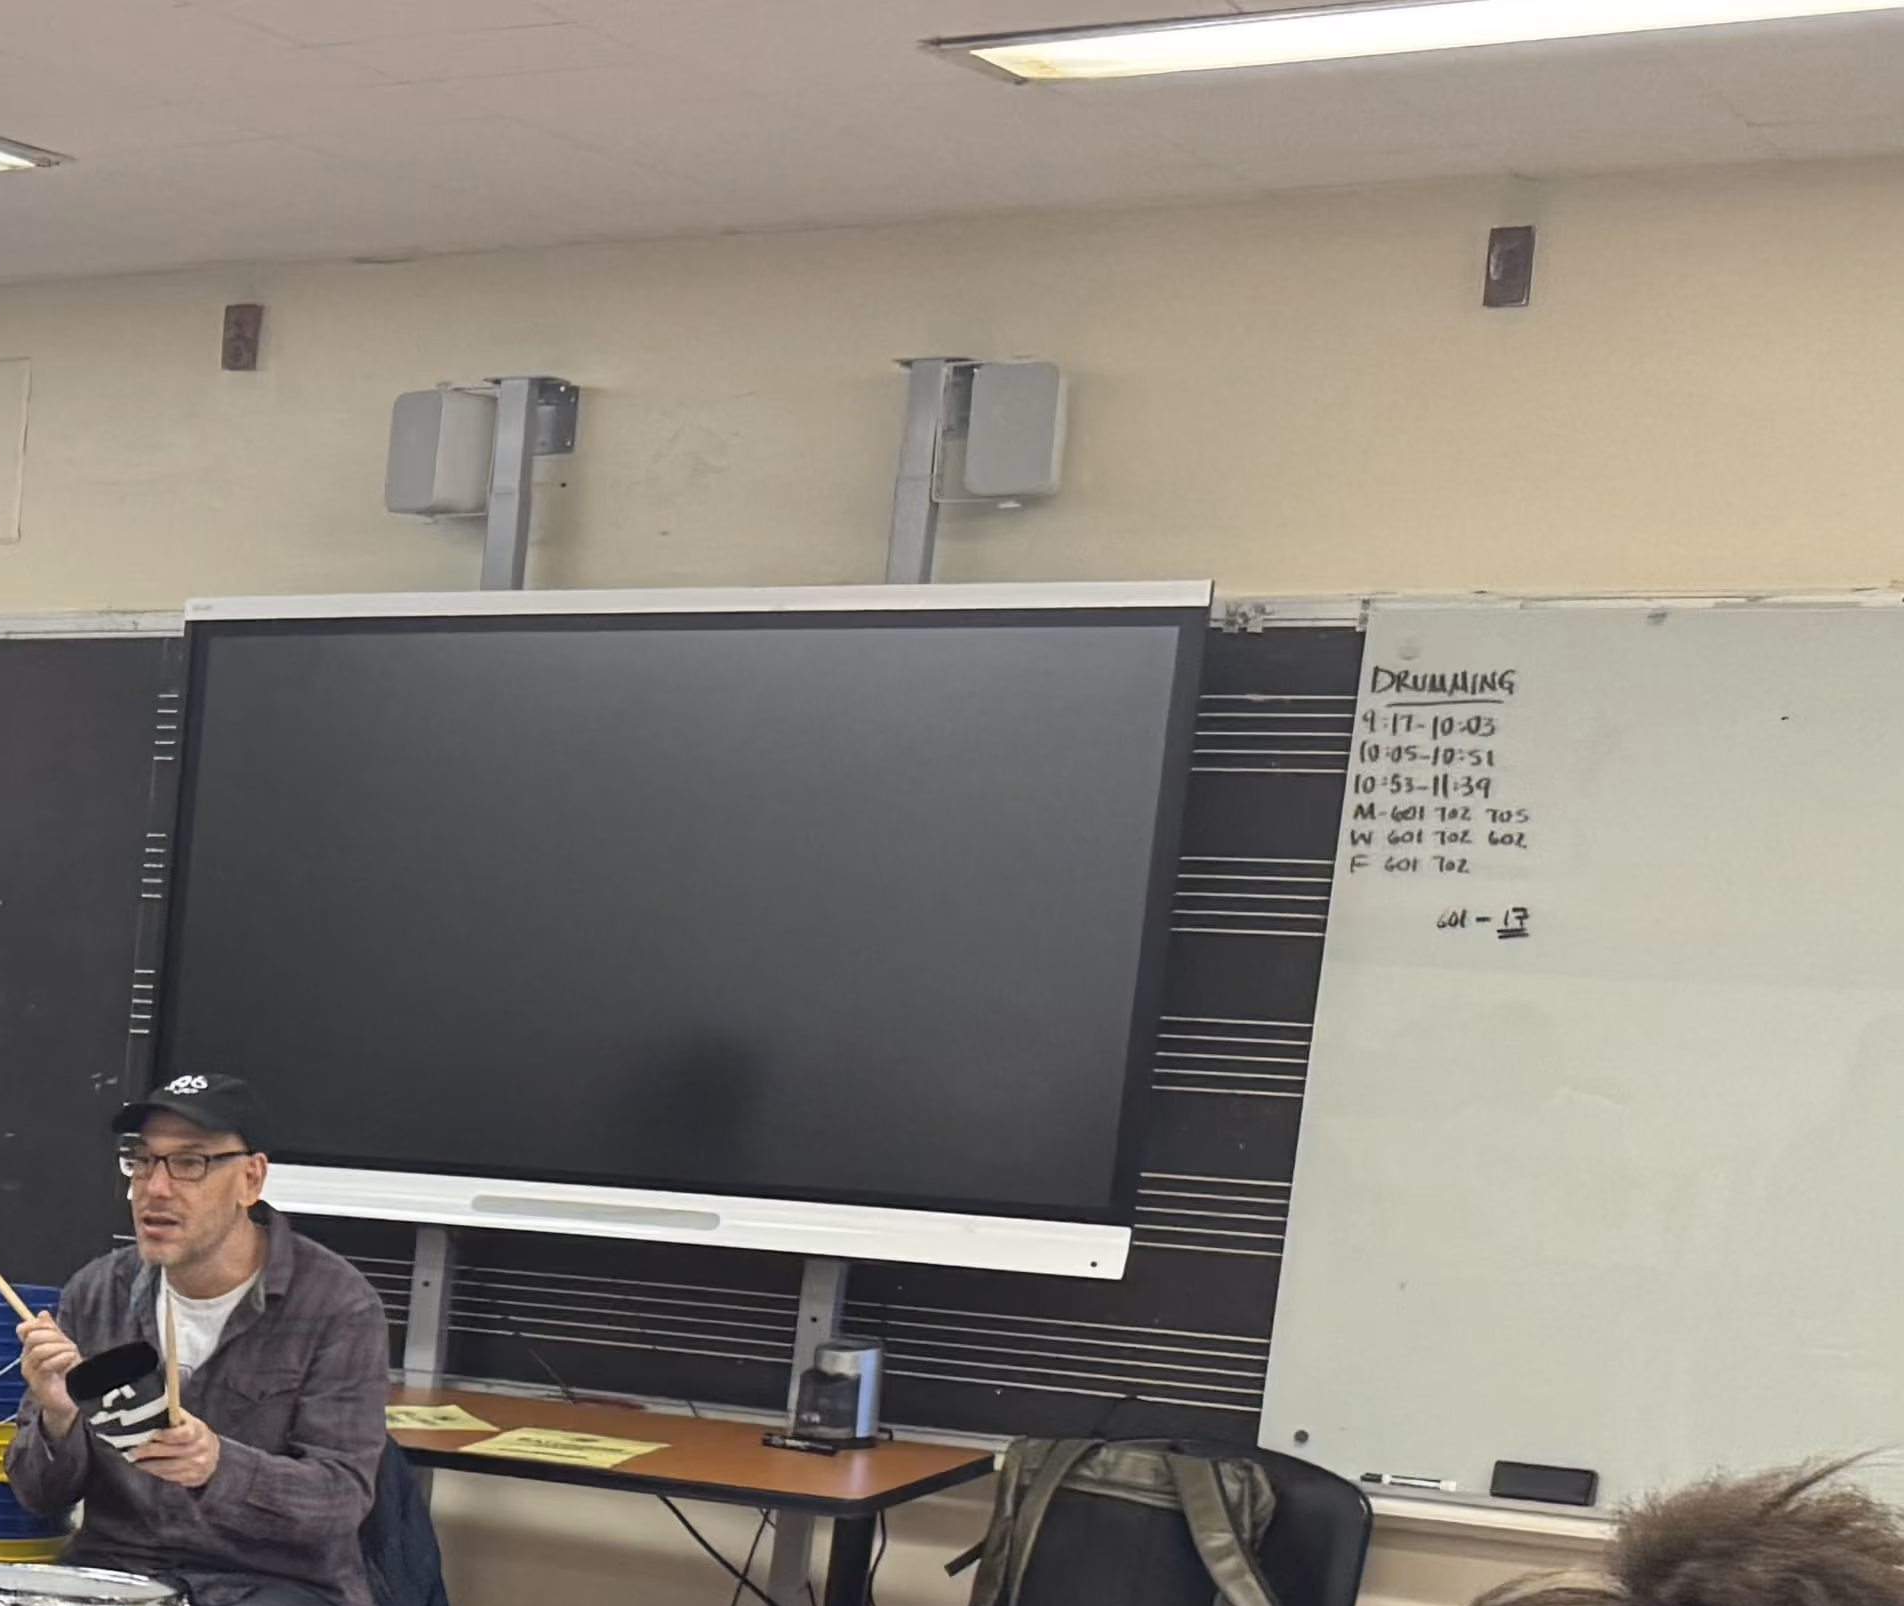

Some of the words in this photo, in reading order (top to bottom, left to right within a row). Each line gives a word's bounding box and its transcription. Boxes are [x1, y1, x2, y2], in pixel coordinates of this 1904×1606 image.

[1371, 666, 1516, 697] DRUMMING
[1434, 805, 1473, 822] 702
[1485, 807, 1530, 824] 705
[1350, 828, 1374, 847] W
[1387, 828, 1424, 846] 601
[1433, 829, 1473, 846] 702
[1487, 829, 1528, 849] 602
[1349, 854, 1369, 874] F
[1384, 856, 1418, 873] 601
[1432, 855, 1471, 874] 702
[1437, 909, 1468, 929] 601
